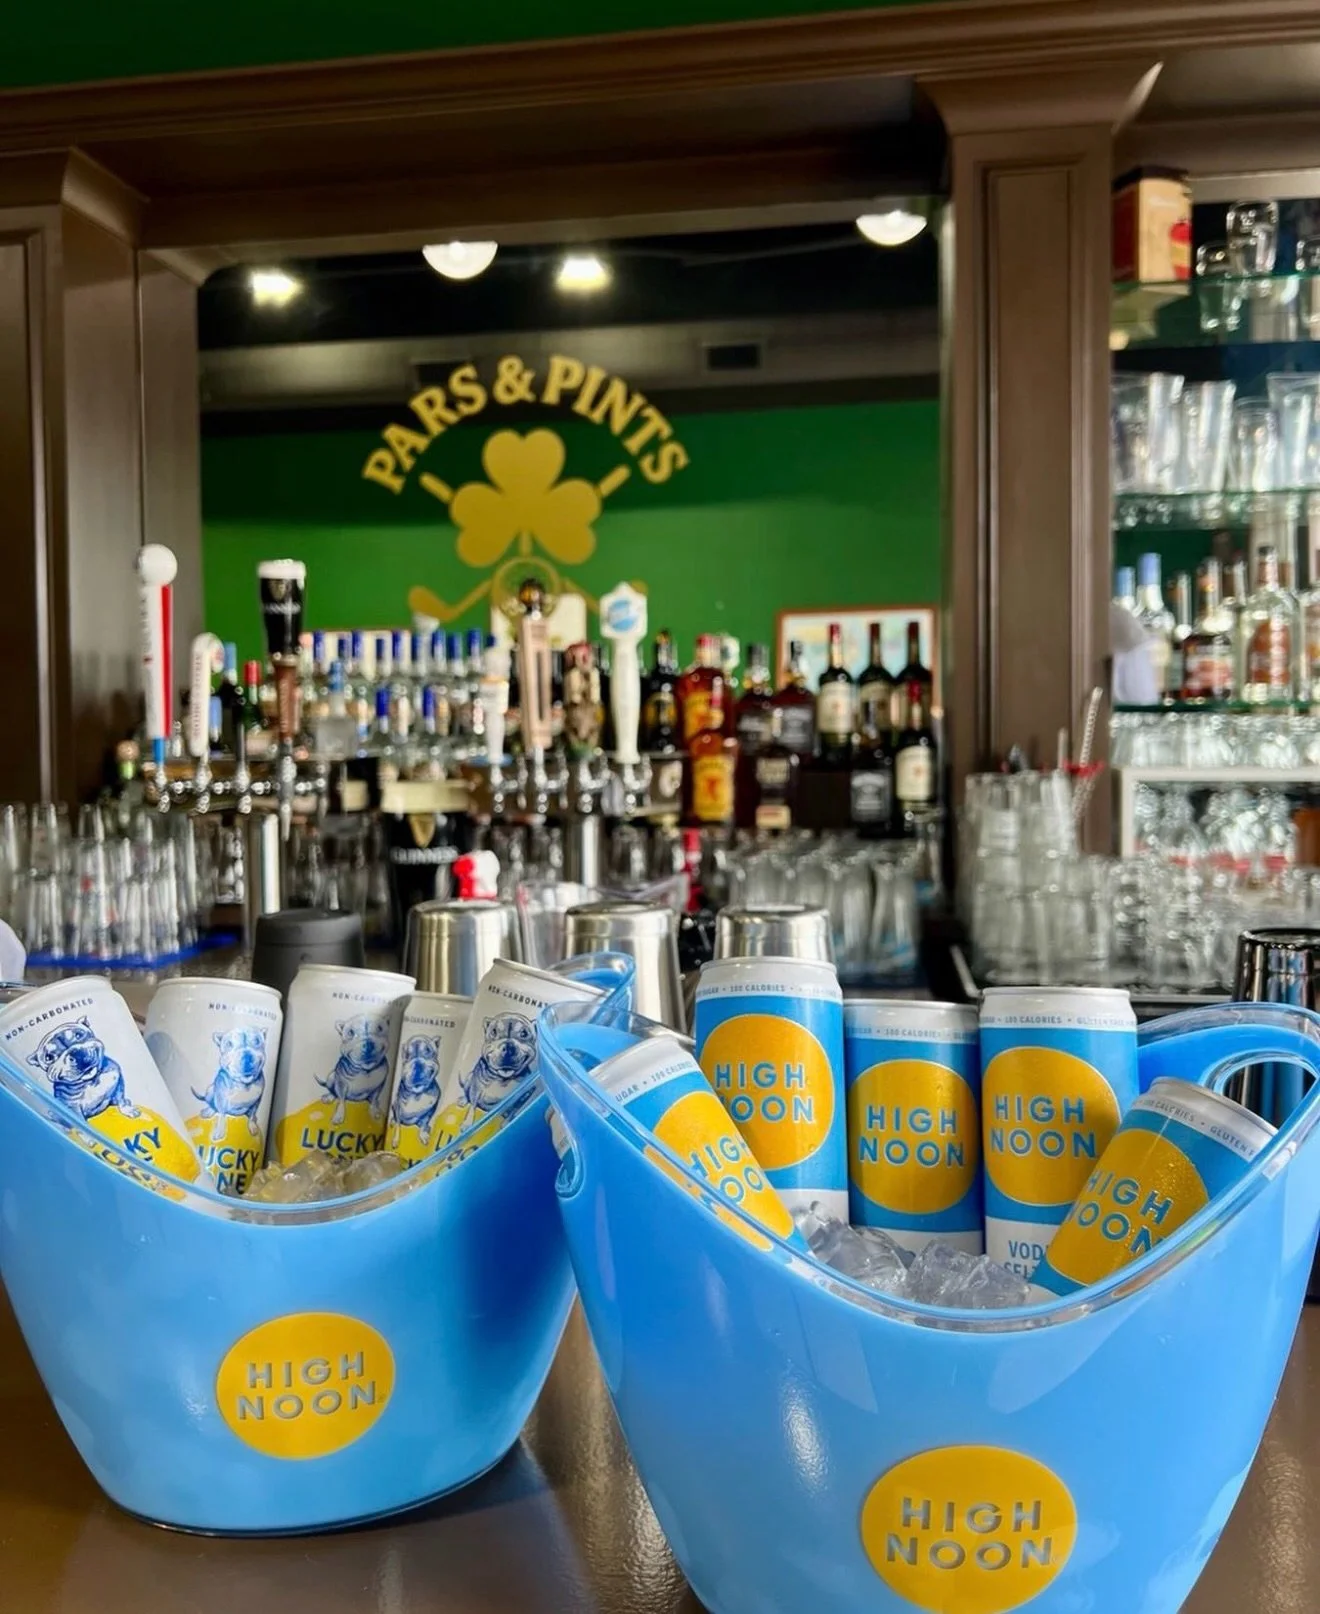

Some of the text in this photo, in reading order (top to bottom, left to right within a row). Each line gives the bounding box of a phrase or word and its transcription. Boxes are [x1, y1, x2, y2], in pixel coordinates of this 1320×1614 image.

[362, 354, 690, 494] PARS & PINTS
[488, 984, 549, 1008] NON-CARBONAT
[745, 984, 785, 992] CALORIES
[5, 998, 93, 1041] NON-CARBONATED
[1020, 1016, 1062, 1024] CALORIES
[715, 1062, 805, 1088] HIGH
[615, 1084, 640, 1102] UGAR
[720, 1094, 815, 1122] OON
[867, 1104, 957, 1135] HIGH
[995, 1095, 1085, 1124] HIGH
[302, 1128, 384, 1154] LUCKY
[858, 1135, 964, 1168] NOON
[991, 1128, 1096, 1158] NOON
[1210, 1126, 1247, 1153] GLUTEN
[198, 1146, 260, 1171] UCKY
[217, 1171, 247, 1195] NE
[1008, 1240, 1046, 1261] VOD
[248, 1351, 364, 1389] HIGH
[237, 1381, 376, 1420] NOON
[902, 1497, 1041, 1534] HIGH
[886, 1533, 1053, 1571] NOON
